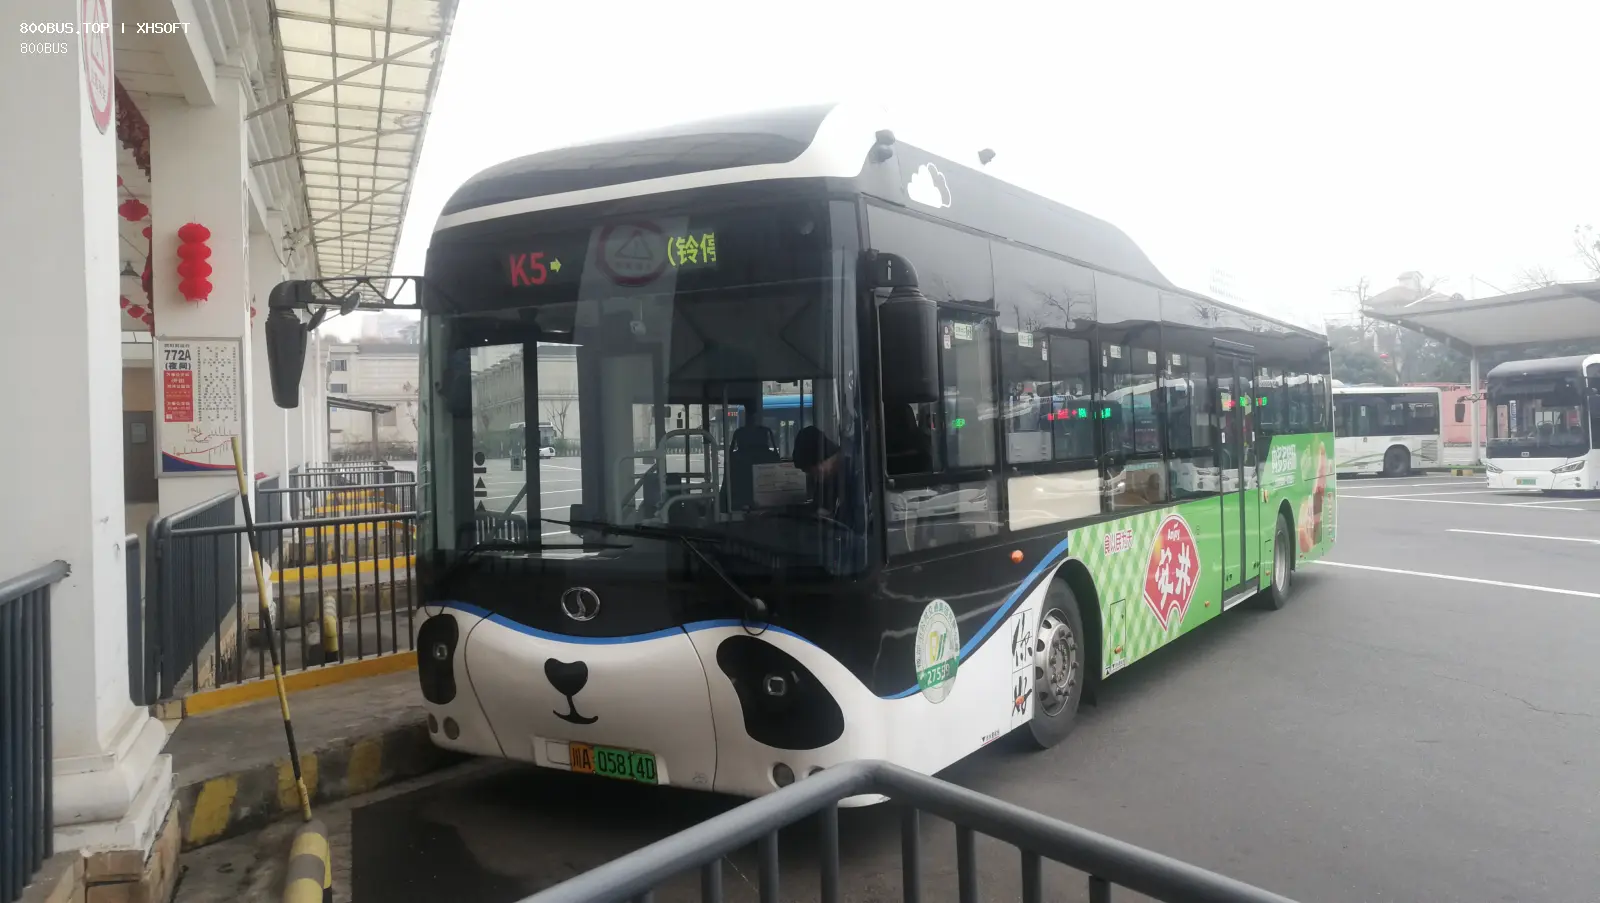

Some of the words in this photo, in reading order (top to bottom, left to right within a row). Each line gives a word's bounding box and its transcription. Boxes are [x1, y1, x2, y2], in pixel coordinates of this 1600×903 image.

[509, 251, 548, 288] K5
[164, 349, 192, 361] 772A
[597, 751, 655, 779] 05814D
